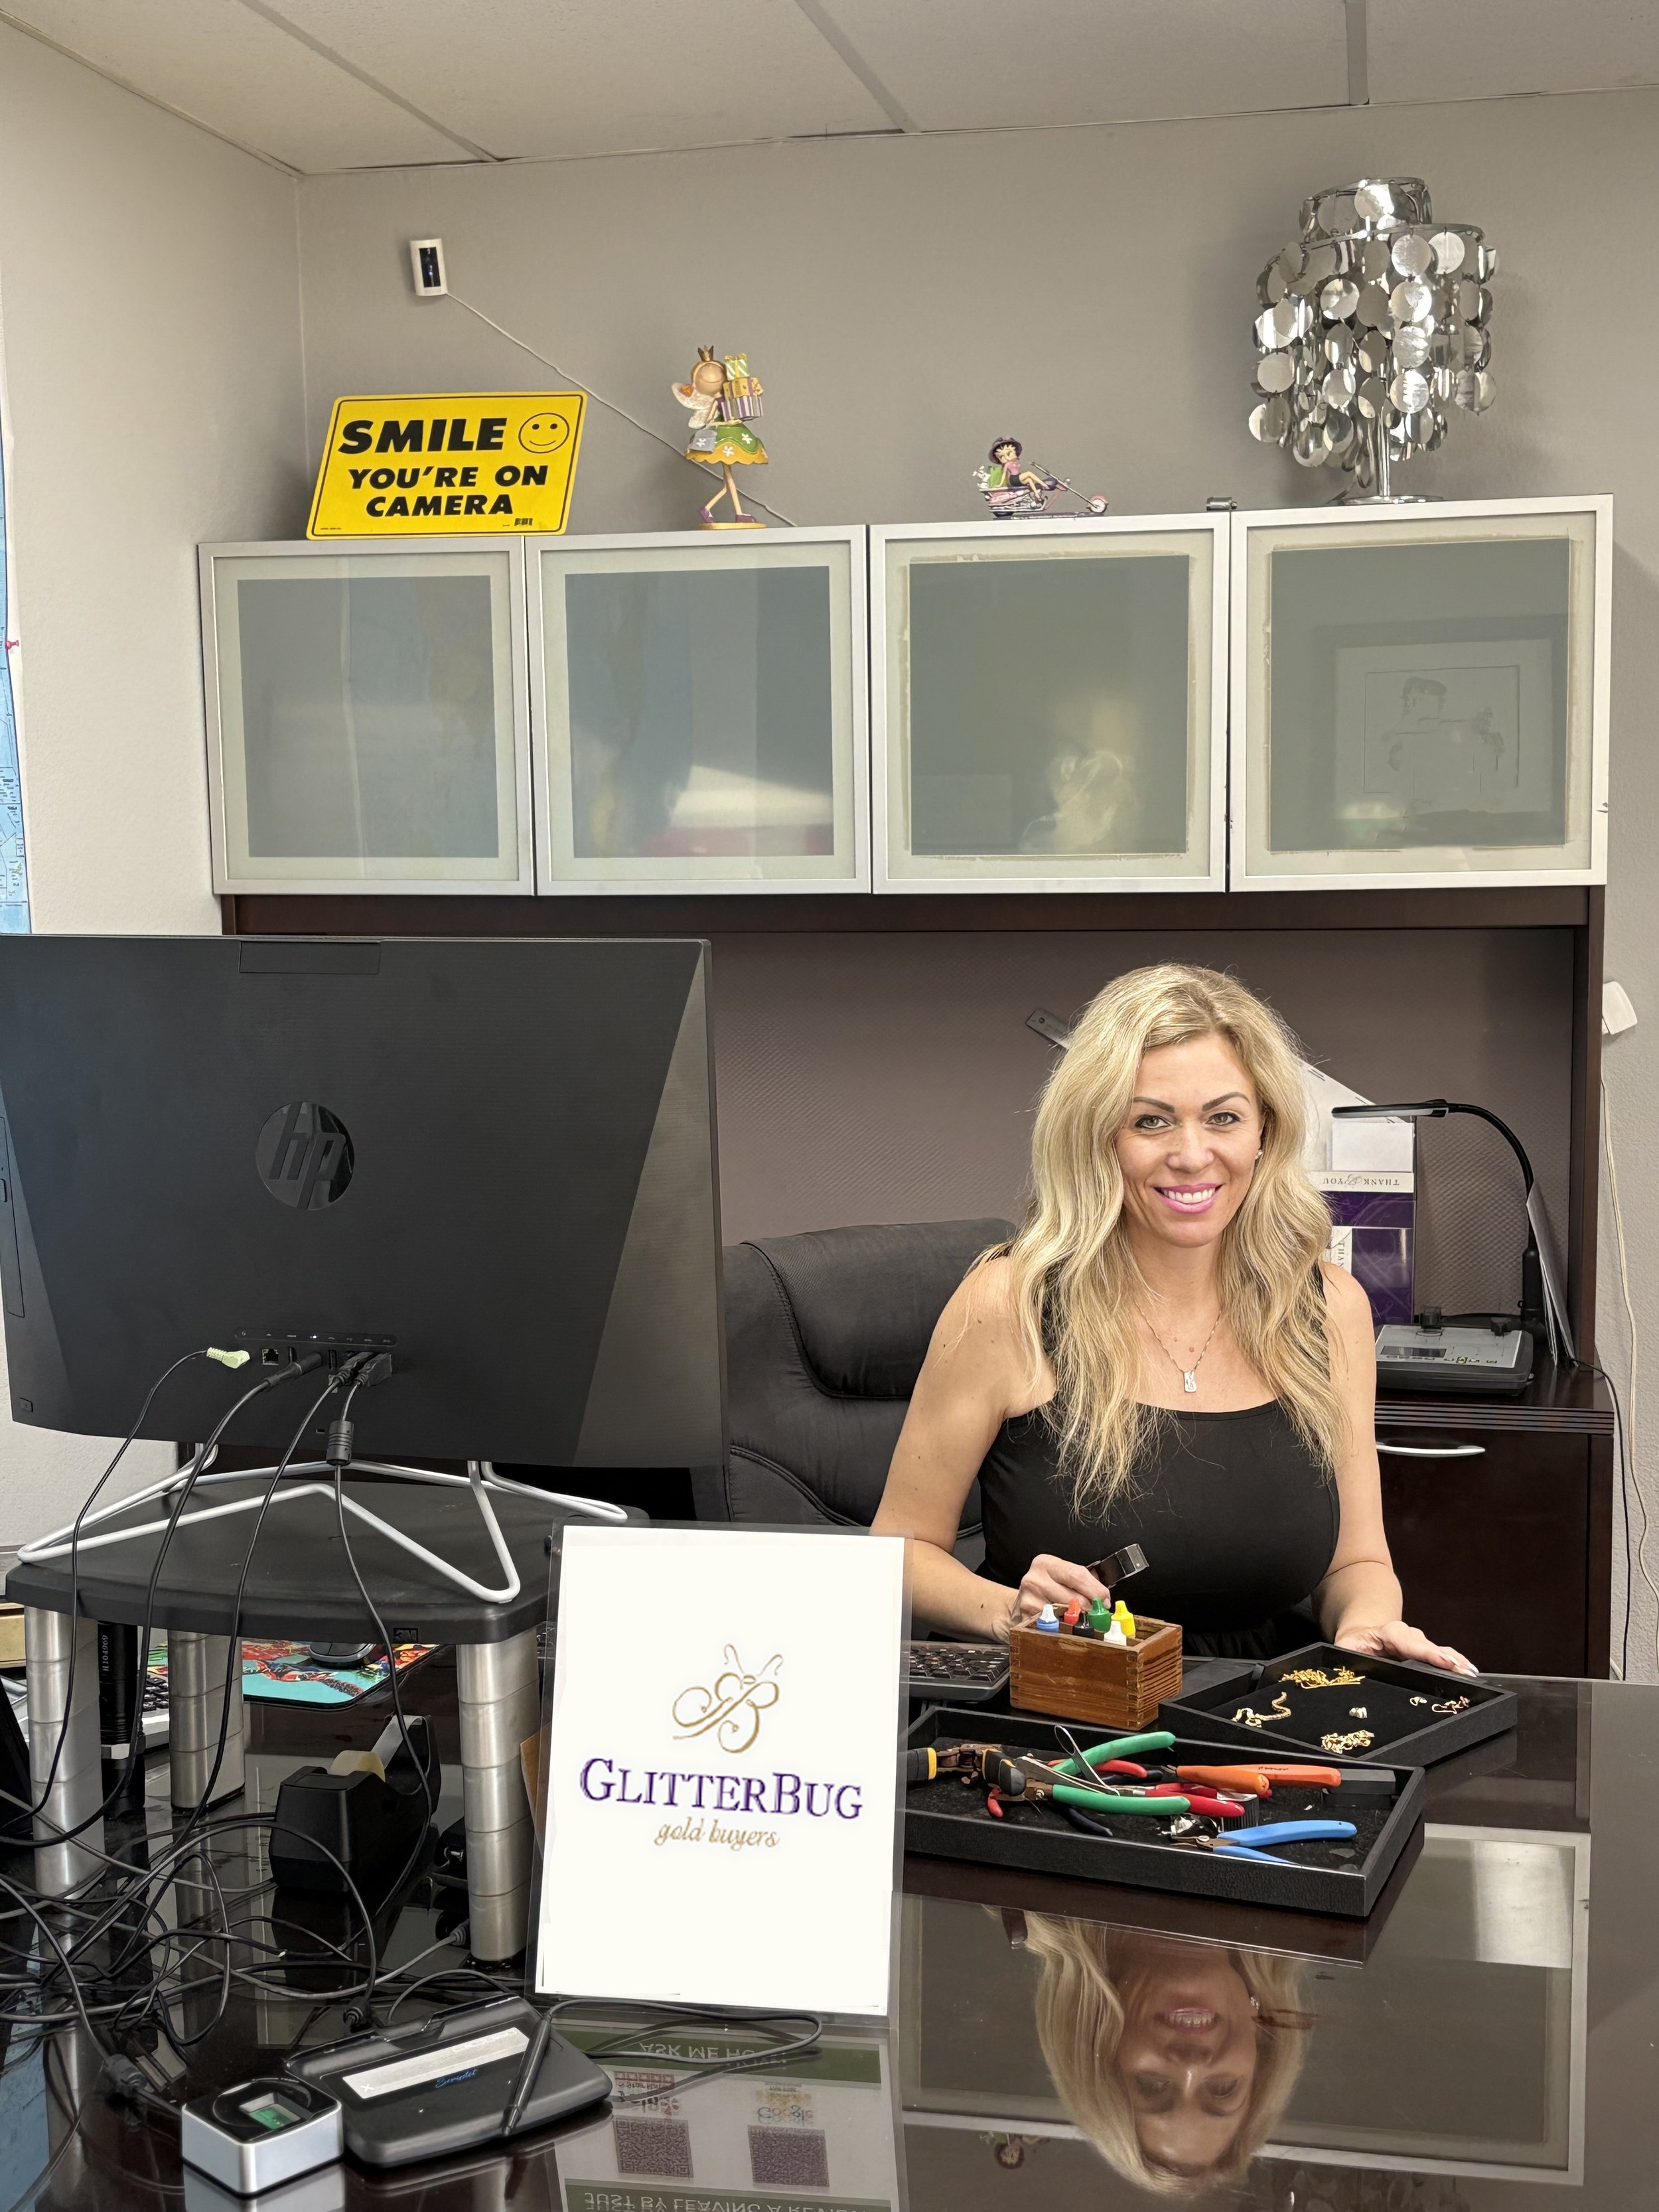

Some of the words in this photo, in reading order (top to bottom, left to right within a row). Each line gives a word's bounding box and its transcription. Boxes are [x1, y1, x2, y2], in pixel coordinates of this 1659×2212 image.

[338, 417, 507, 454] SMILE
[348, 466, 478, 489] YOU'RE
[494, 465, 548, 487] ON
[366, 494, 514, 517] CAMERA
[269, 1101, 346, 1211] hp
[654, 1816, 706, 1846] gold
[709, 1818, 780, 1851] buyers
